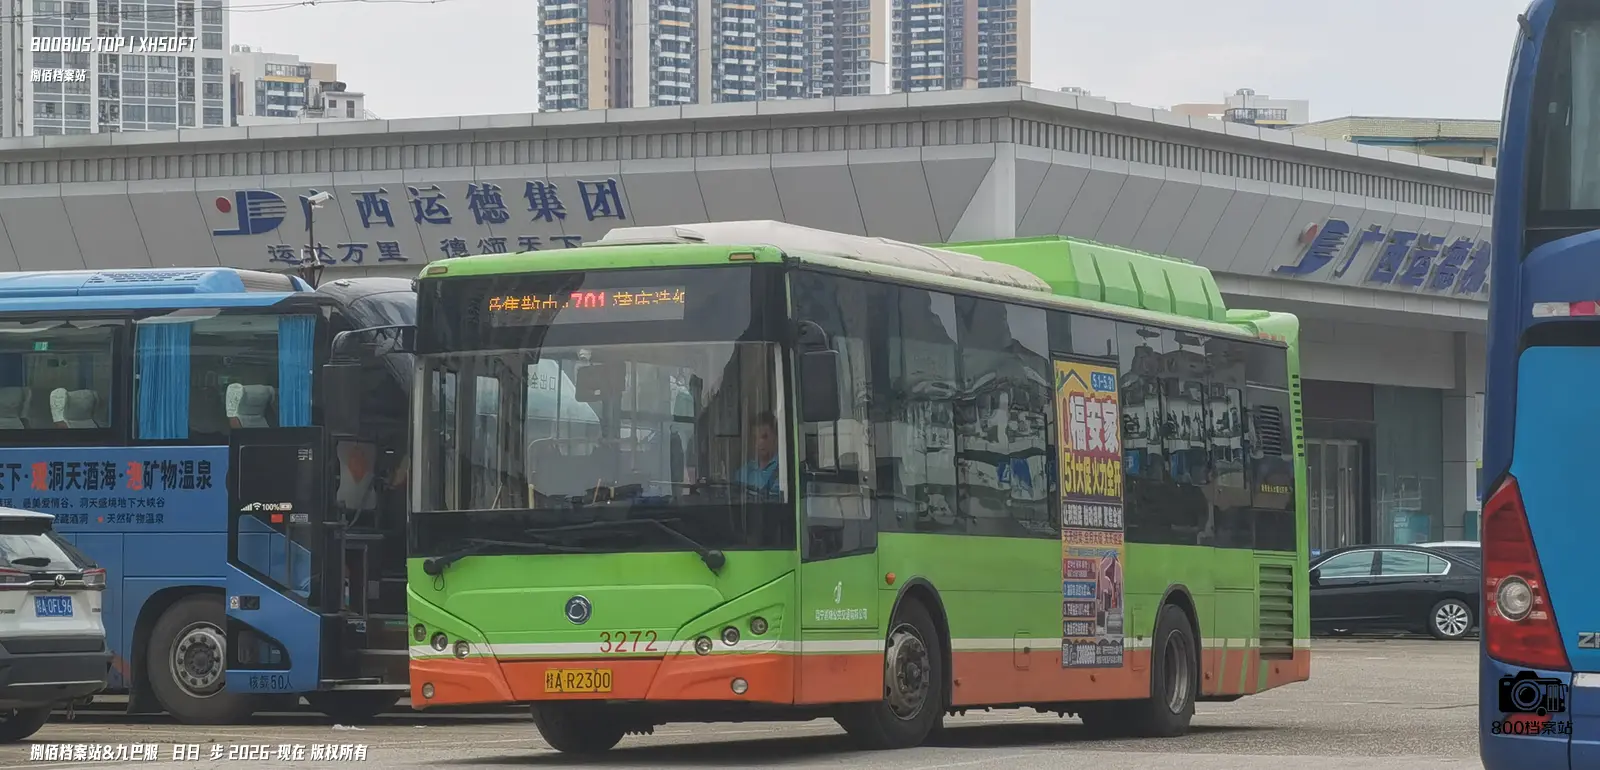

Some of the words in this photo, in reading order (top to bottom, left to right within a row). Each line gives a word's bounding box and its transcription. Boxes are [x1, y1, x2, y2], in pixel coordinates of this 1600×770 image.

[299, 177, 625, 234] 广西运德集团
[267, 241, 409, 265] 运达万里
[570, 291, 604, 308] 701
[0, 460, 213, 491] 下·观洞天酒海·泡矿物温泉
[599, 630, 658, 653] 3272
